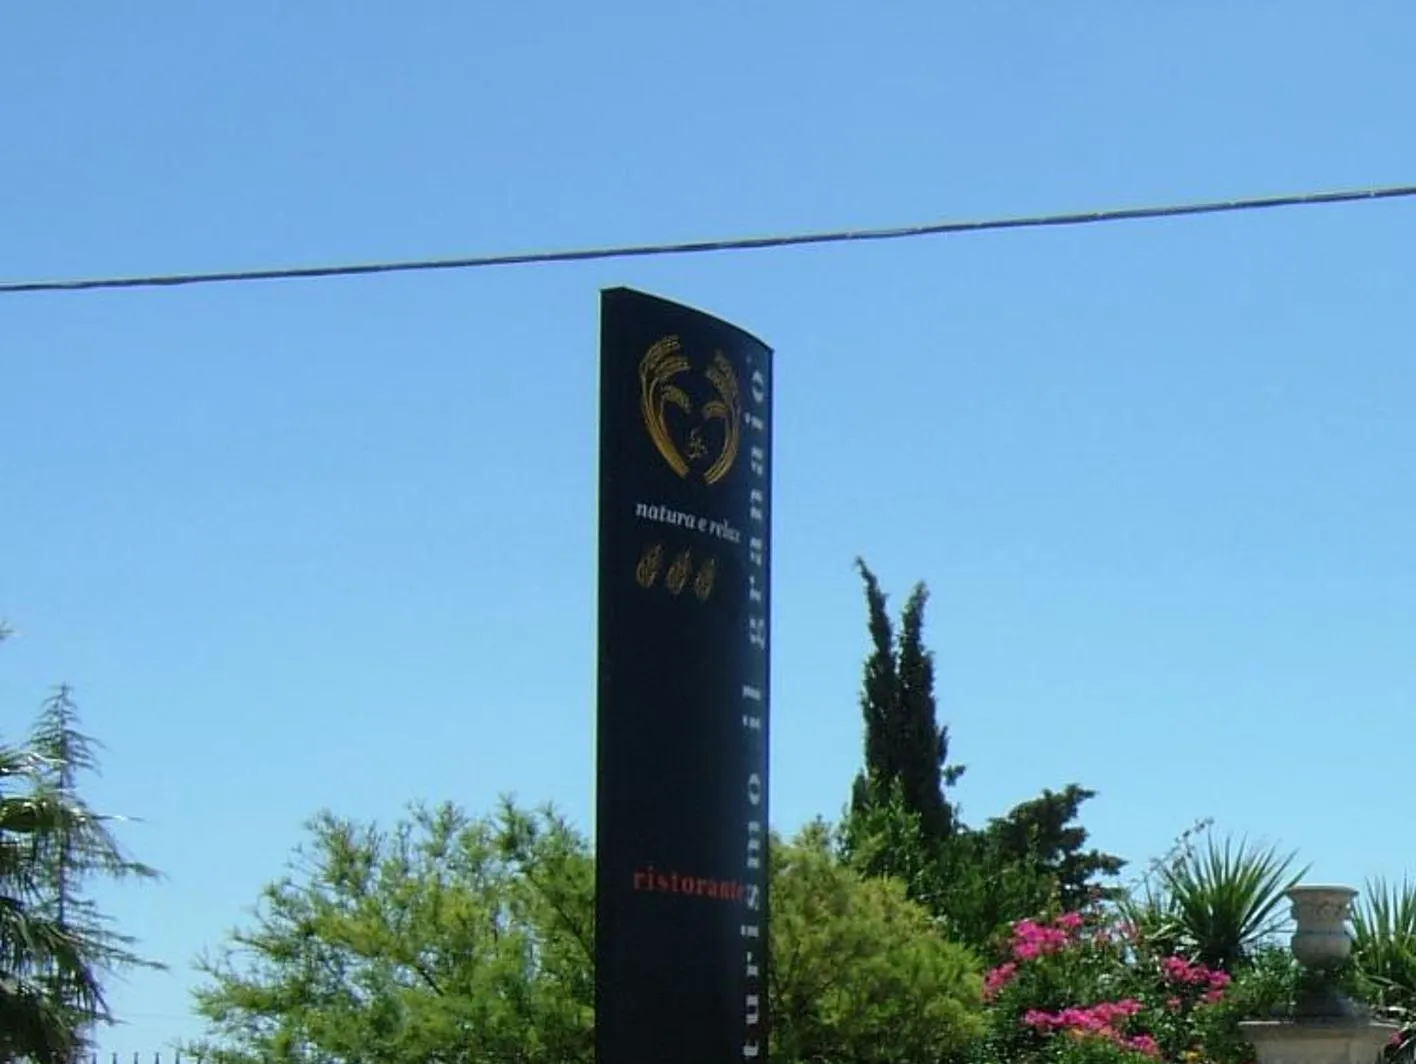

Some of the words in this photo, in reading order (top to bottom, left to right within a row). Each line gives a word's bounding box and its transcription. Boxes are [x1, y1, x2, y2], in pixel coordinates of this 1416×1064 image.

[636, 503, 696, 529] natura
[697, 517, 708, 532] e
[710, 518, 742, 544] relax
[745, 370, 765, 650] granaio
[742, 685, 761, 730] il
[633, 865, 745, 902] ristorante
